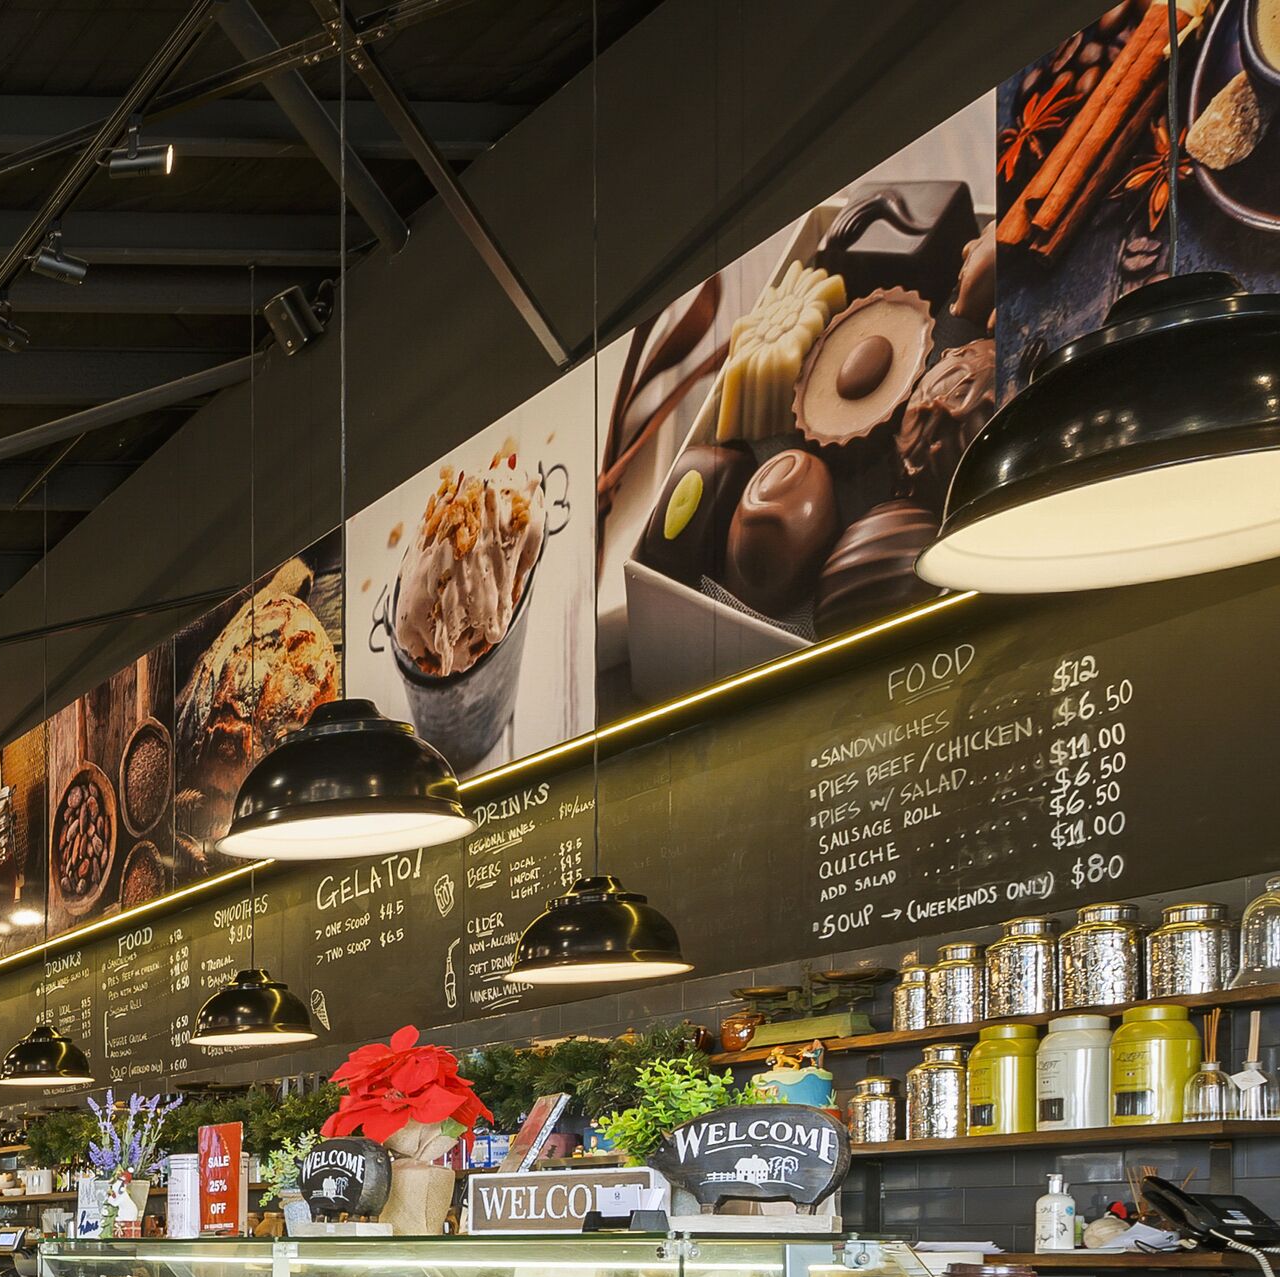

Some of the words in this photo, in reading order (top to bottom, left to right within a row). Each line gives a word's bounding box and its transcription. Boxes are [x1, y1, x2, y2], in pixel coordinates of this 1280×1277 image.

[888, 644, 975, 700] FOOD
[818, 709, 950, 768] SANDWICHES
[1051, 655, 1099, 692] $12
[818, 773, 859, 801] PIES
[866, 717, 1033, 786] BEEF/CHICKEN
[1056, 679, 1133, 726] $6.50
[818, 801, 861, 828] PIES
[900, 768, 967, 805] SALAD
[1049, 722, 1126, 766] $11.00
[472, 782, 550, 828] DRINKS
[819, 818, 892, 854] SAUSAGE
[903, 803, 942, 828] ROLL
[1050, 751, 1127, 797] $6.50
[468, 832, 505, 856] REGIONAL
[507, 820, 536, 841] WINES
[819, 841, 900, 879] QUICHE
[1049, 781, 1121, 818] $6.50
[467, 861, 501, 888] BEERS
[509, 856, 536, 872] LOCAL
[820, 883, 847, 902] ADD
[855, 870, 897, 891] SALAD
[1050, 811, 1126, 850] $11.00
[316, 847, 423, 910] GELATO!
[509, 867, 541, 887] IMPORT
[511, 882, 540, 899] LIGHT
[213, 893, 269, 928] SMOOTHES
[325, 921, 342, 938] ONE
[344, 912, 371, 932] SCOOP
[379, 900, 404, 920] $4.5
[467, 912, 505, 934] CIDER
[818, 903, 874, 939] SOUP
[118, 926, 153, 957] FOOD
[325, 947, 343, 963] TWO
[347, 938, 371, 954] SCOOP
[379, 928, 404, 948] $6.5
[45, 951, 82, 978] DRINKS
[468, 961, 489, 976] SOFT
[469, 986, 503, 1004] MINERAL
[110, 1065, 127, 1079] SOUP
[674, 1120, 837, 1165] WELCOME
[207, 1156, 230, 1168] SALE
[302, 1149, 366, 1184] WELCOME
[209, 1180, 228, 1192] 25%
[479, 1183, 644, 1220] WELCO
[210, 1203, 227, 1215] OFF
